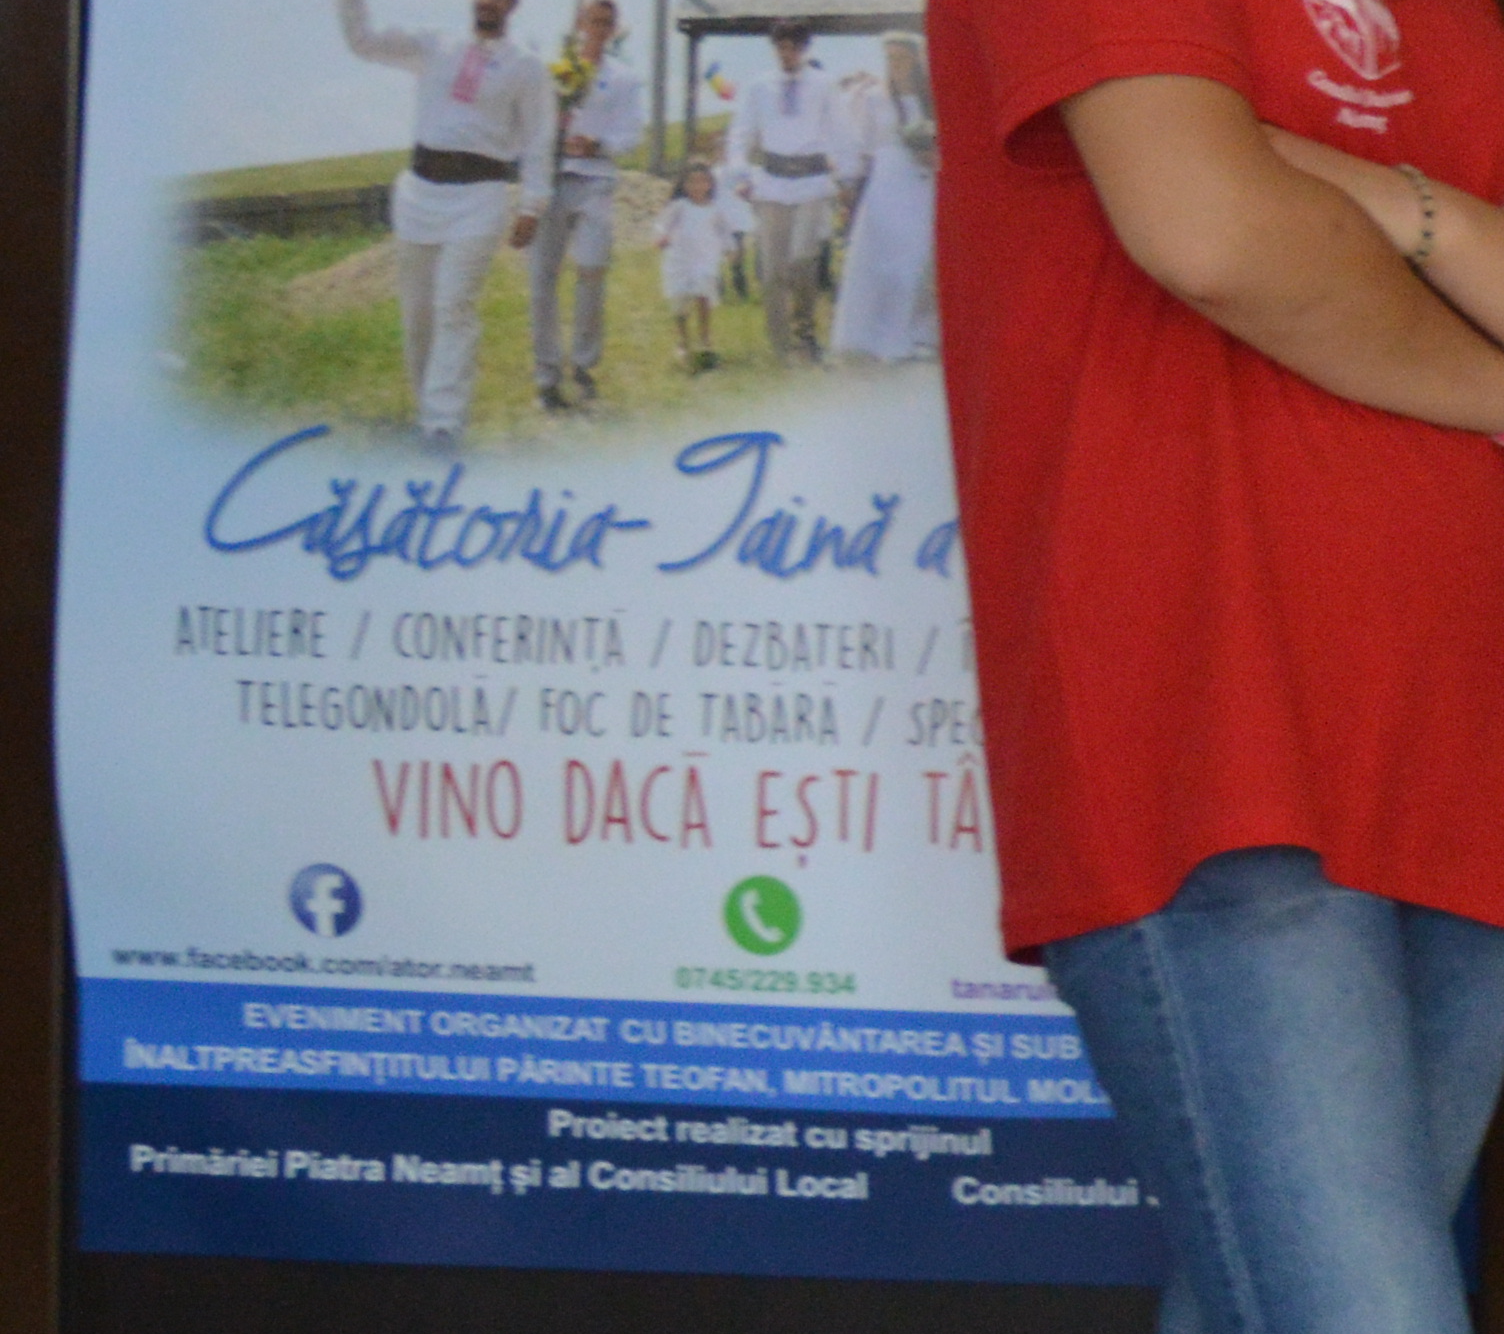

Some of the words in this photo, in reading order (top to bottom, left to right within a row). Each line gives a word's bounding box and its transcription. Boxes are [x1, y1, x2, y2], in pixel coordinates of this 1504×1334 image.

[173, 604, 329, 659] ATELIERE
[692, 618, 896, 672] DEZBATERI
[539, 687, 608, 738] FOC
[629, 690, 675, 740] DE
[371, 757, 526, 841] VINO
[241, 1001, 426, 1036] EVENIMENT
[430, 1010, 610, 1043] ORGANIZAT
[620, 1018, 667, 1046] CU
[1010, 1033, 1084, 1061] SUB
[784, 1069, 1022, 1105] MITROPOLITUL
[547, 1108, 671, 1144] Proiect
[676, 1117, 799, 1149] realizat
[804, 1127, 848, 1151] cu
[855, 1125, 993, 1162] sprijinul
[283, 1151, 386, 1183] Piatra
[548, 1161, 580, 1189] al
[588, 1161, 769, 1198] Consiliului
[776, 1169, 870, 1202] Local
[952, 1175, 1140, 1209] Consiliului
